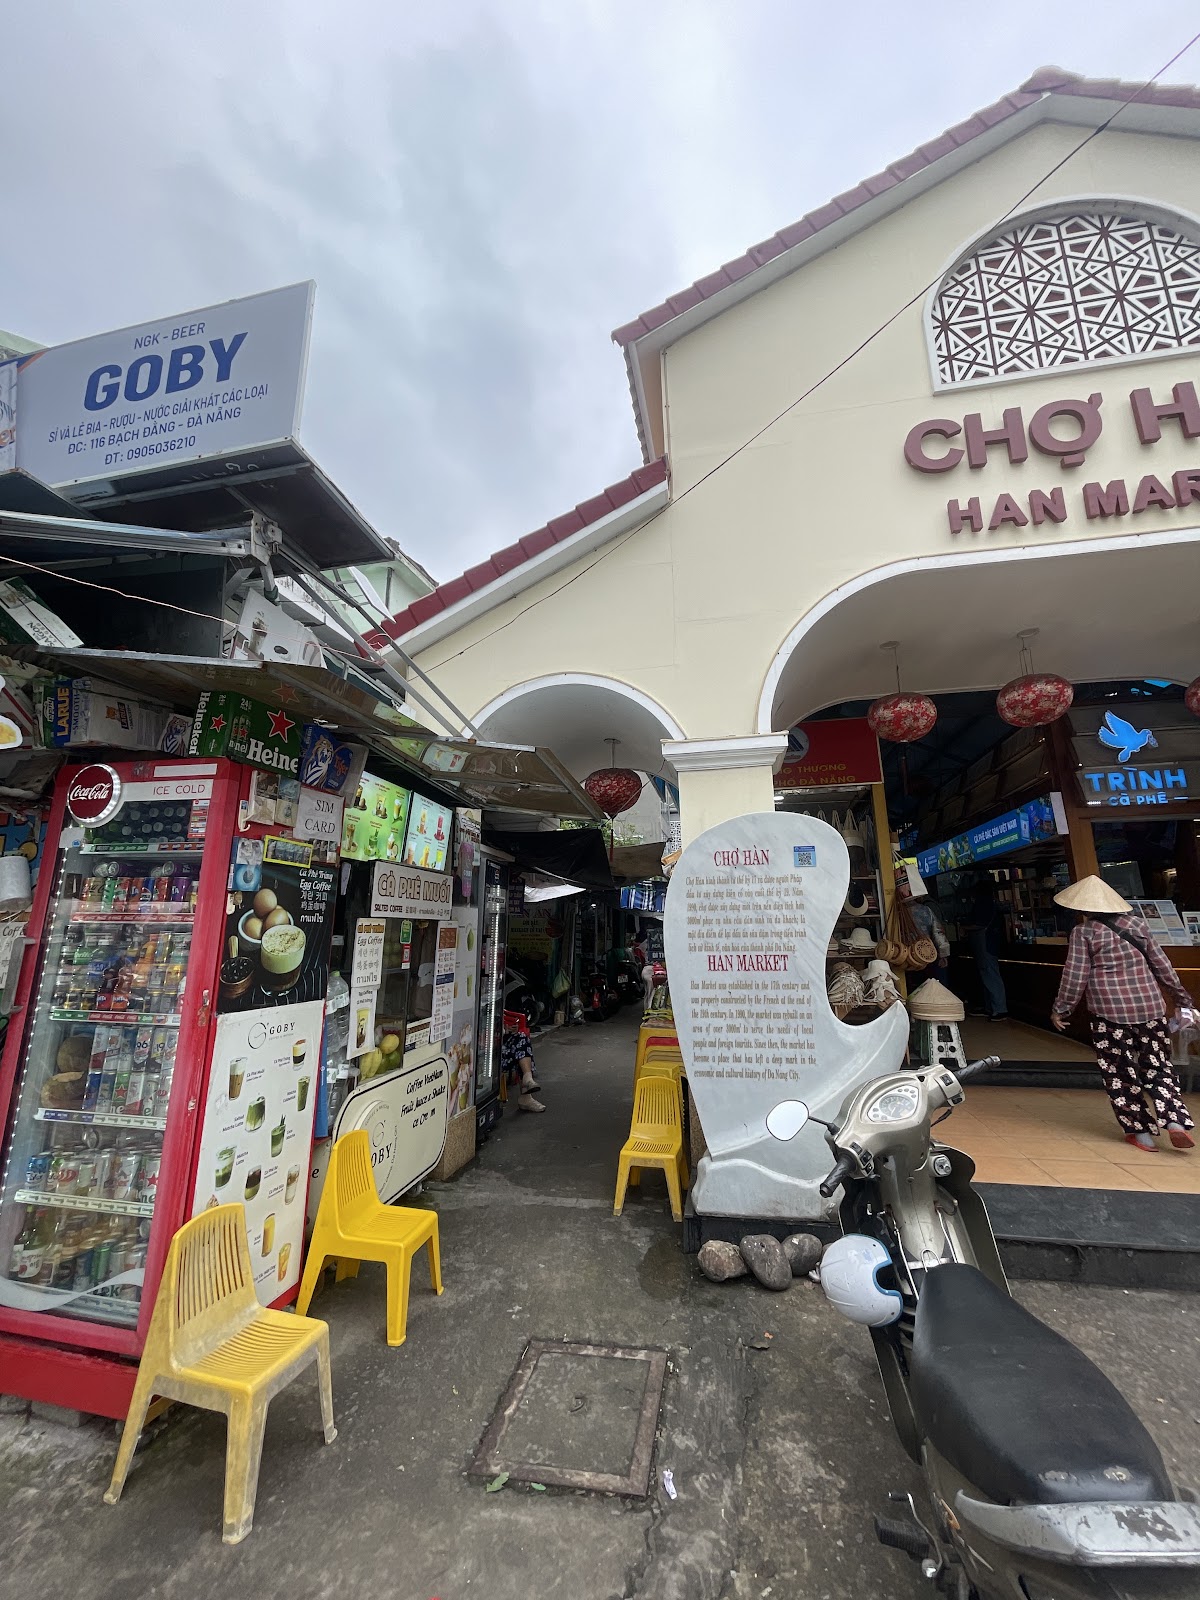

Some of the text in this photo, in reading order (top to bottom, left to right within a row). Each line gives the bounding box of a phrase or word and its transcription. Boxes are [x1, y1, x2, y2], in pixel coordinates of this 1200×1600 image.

[134, 322, 206, 349] NGK BEER
[83, 332, 248, 411] GOBY
[60, 424, 71, 441] VÀ
[86, 419, 101, 435] BIA
[109, 410, 135, 432] RƯỢU
[144, 403, 170, 427] NƯỚC
[172, 397, 192, 418] GIẢI
[193, 391, 220, 412] KHÁT
[222, 386, 243, 406] CÁC
[245, 382, 268, 403] LOẠI
[68, 439, 87, 455] ĐC:
[90, 435, 105, 450] 116
[108, 428, 140, 449] BẠCH
[187, 413, 203, 429] ĐÀ
[206, 405, 242, 425] NẴNG
[904, 391, 1103, 473] CHỢ
[104, 434, 196, 466] ĐT: 0905036210
[947, 486, 1067, 534] HAN
[57, 687, 70, 736] LARUE
[189, 691, 211, 756] Heineken
[153, 784, 205, 796] ICE COLD
[1084, 767, 1188, 792] TRÌNH
[315, 799, 334, 813] SIM
[1136, 791, 1168, 805] PHÊ
[305, 818, 336, 833] CARD
[714, 844, 769, 869] CHỢ HÀN
[300, 878, 331, 891] Egg Coffee
[398, 875, 421, 900] PHÊ
[374, 904, 389, 912] SALTED
[389, 904, 403, 912] COFFEE
[357, 935, 382, 946] Egg Coffee
[707, 954, 788, 972] HAN MARKET
[269, 1022, 296, 1035] GOBY
[407, 1078, 423, 1095] Coffee
[401, 1100, 414, 1118] Fruit
[414, 1096, 427, 1112] Juice
[431, 1085, 446, 1100] Shake
[370, 1142, 392, 1168] OBY
